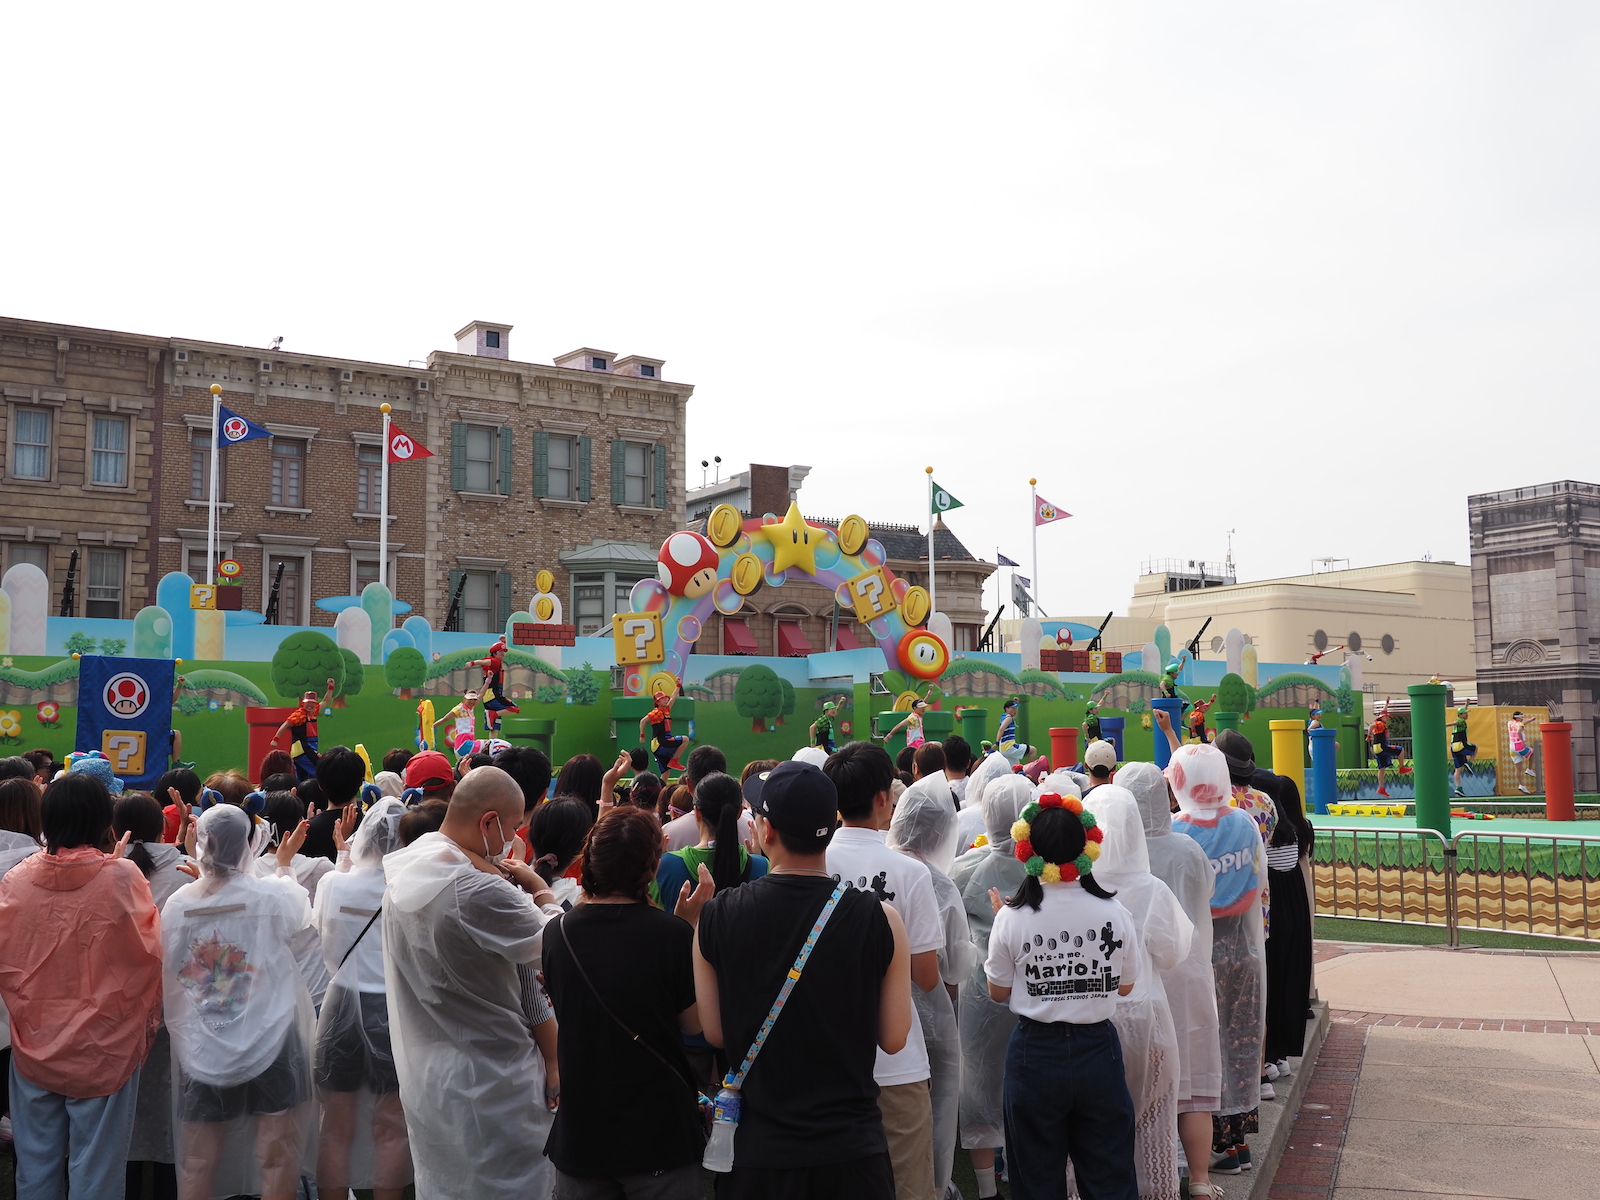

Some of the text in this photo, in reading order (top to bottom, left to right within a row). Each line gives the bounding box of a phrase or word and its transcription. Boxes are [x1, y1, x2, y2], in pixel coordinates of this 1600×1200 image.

[393, 438, 411, 454] M
[938, 492, 947, 507] L
[194, 587, 212, 607] ?
[856, 574, 884, 612] ?
[623, 618, 655, 658] ?
[109, 736, 139, 769] ?
[1067, 951, 1085, 959] me,
[1025, 959, 1099, 980] Mario!
